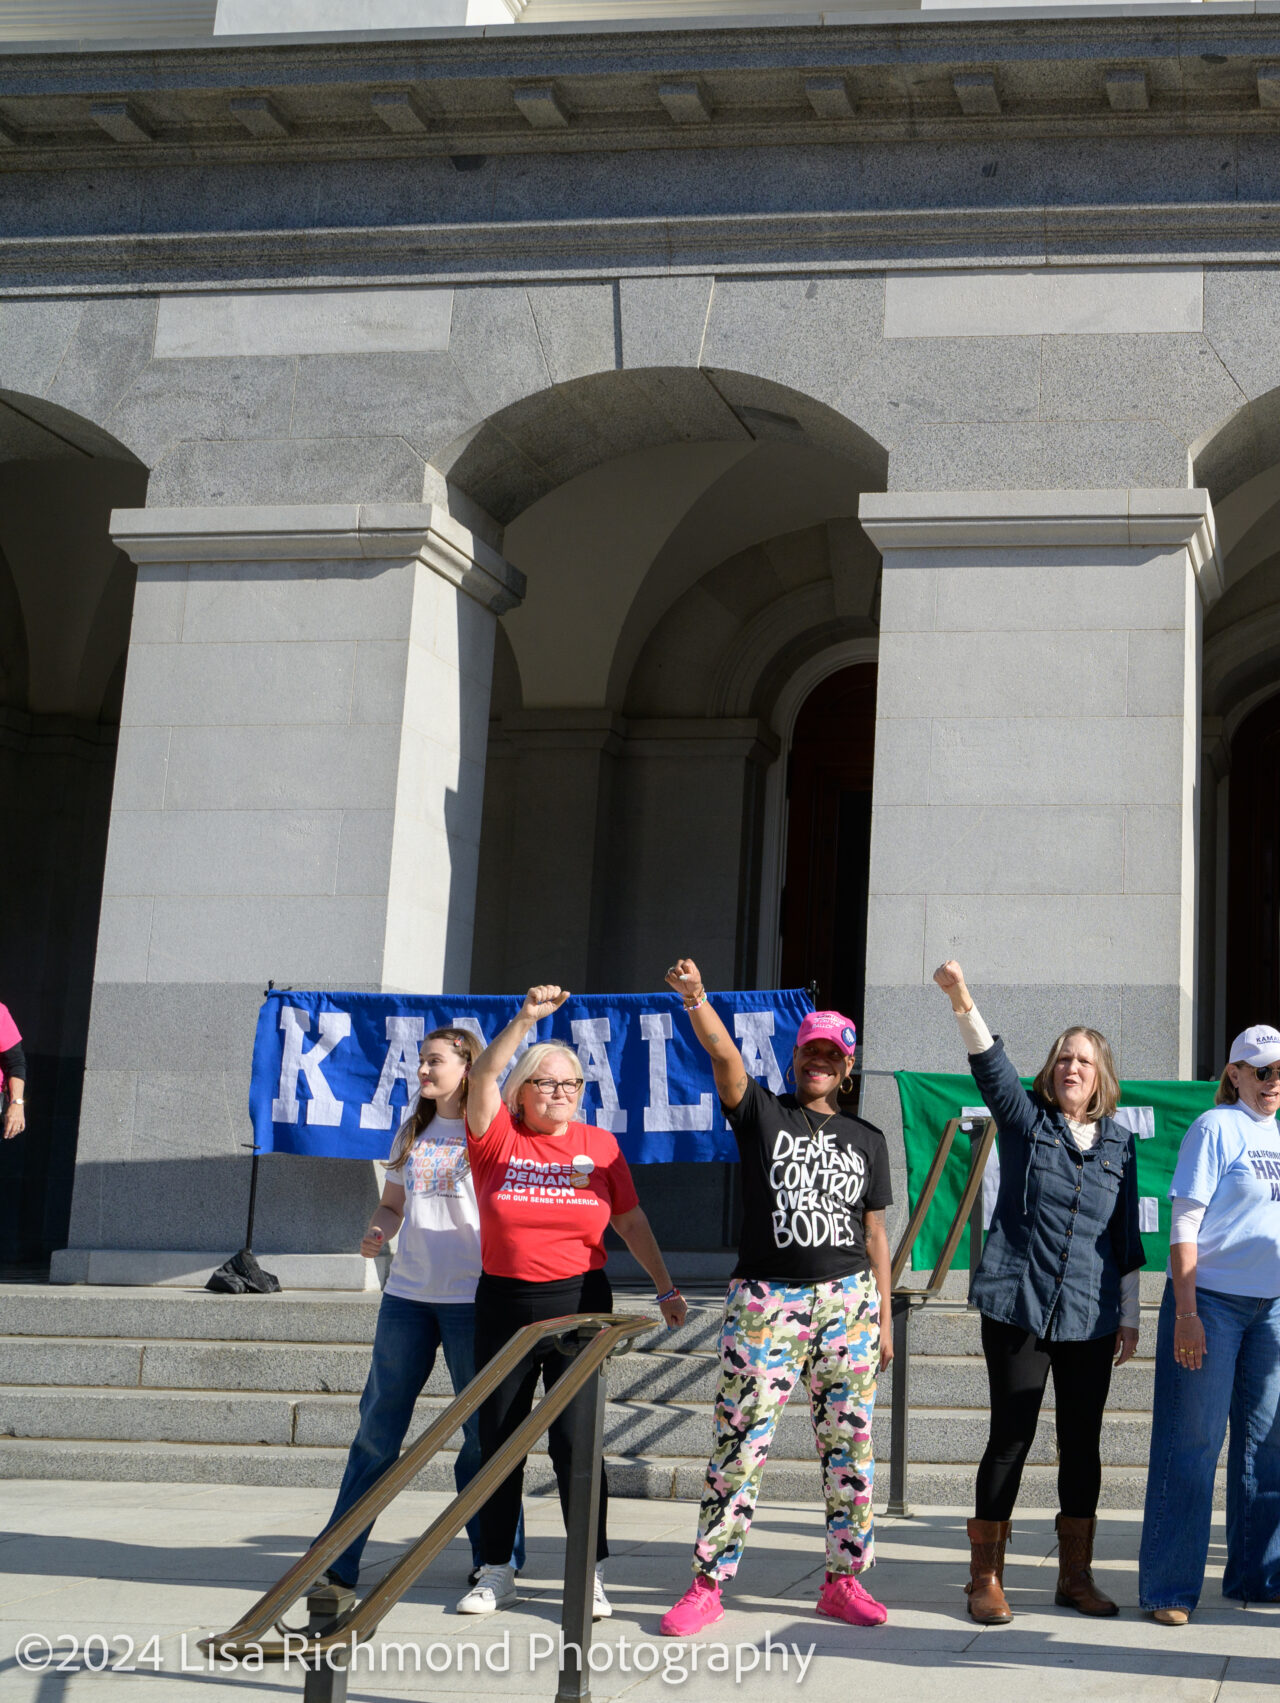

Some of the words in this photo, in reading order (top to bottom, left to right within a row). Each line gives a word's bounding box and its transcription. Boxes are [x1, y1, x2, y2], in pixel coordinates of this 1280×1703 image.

[772, 1130, 865, 1176] DEMAND
[414, 1168, 453, 1179] VOICE
[509, 1155, 561, 1174] MOMS
[504, 1168, 571, 1186] DEMAN
[499, 1181, 575, 1197] ACTION
[566, 1198, 599, 1206] AMERICA
[777, 1188, 822, 1211] OVER
[772, 1210, 855, 1248] BODIES
